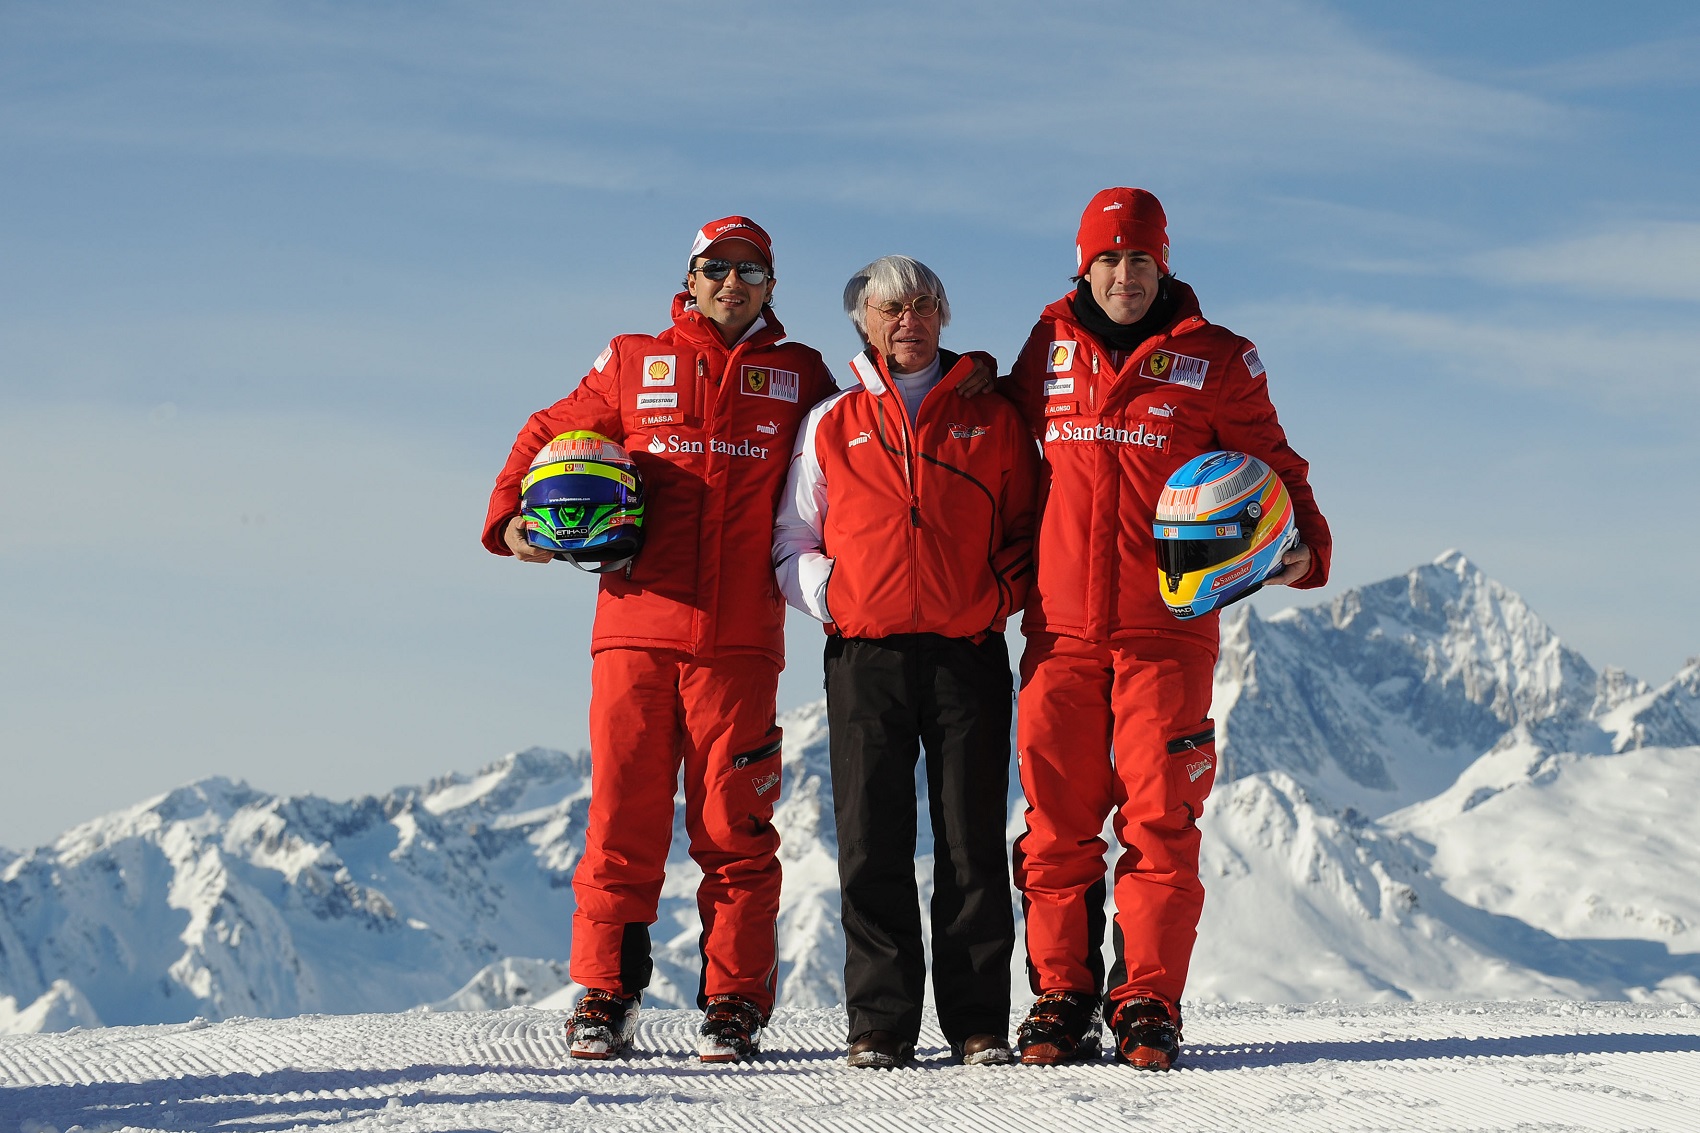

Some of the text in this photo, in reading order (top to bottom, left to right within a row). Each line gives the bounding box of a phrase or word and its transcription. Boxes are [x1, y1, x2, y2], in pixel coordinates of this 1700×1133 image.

[1050, 405, 1071, 413] ALONSO
[1147, 406, 1170, 417] PUMA
[641, 415, 673, 425] F. MASSA
[756, 424, 775, 435] PUMA
[1061, 421, 1167, 448] Santander
[848, 436, 868, 448] PUMA
[556, 528, 588, 536] ETIHAD
[1219, 566, 1250, 585] Santander
